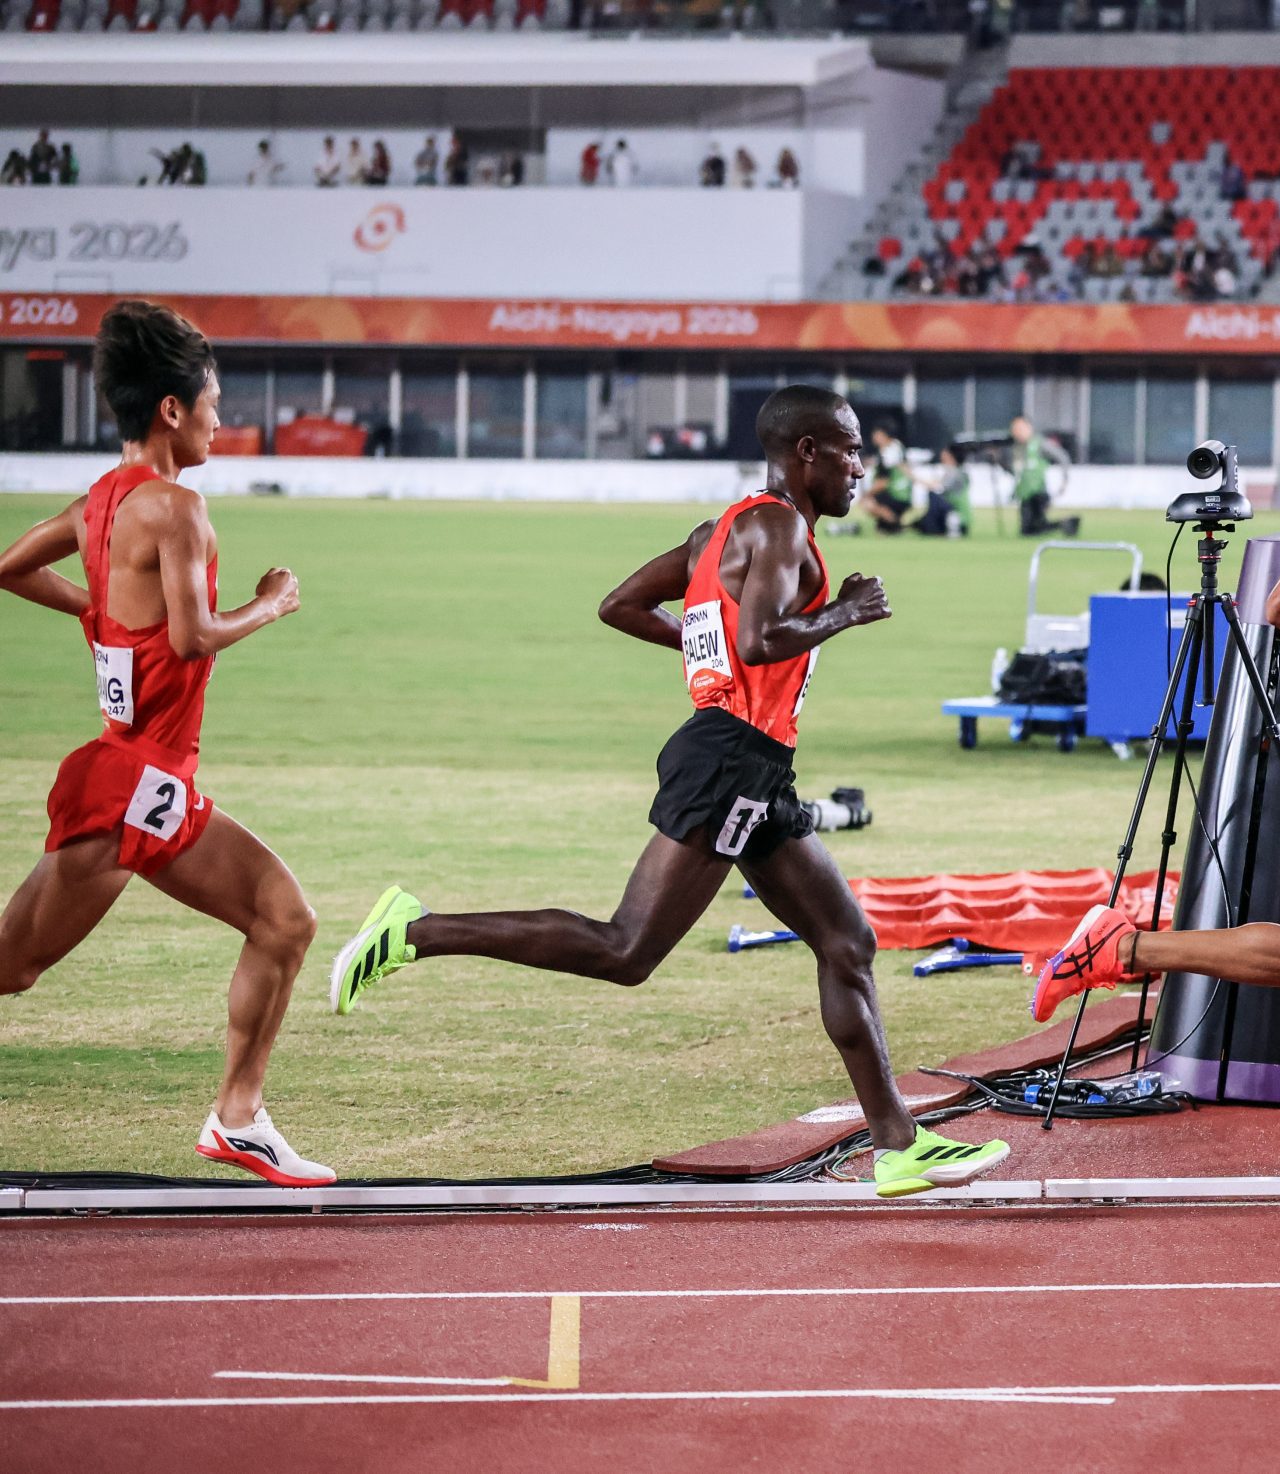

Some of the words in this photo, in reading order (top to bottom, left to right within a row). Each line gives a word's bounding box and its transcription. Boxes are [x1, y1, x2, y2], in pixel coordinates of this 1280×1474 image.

[69, 221, 189, 263] 2026
[9, 298, 78, 325] 2026
[490, 304, 682, 341] Aichi-Nagoya
[687, 307, 759, 334] 2026
[711, 658, 724, 669] 206
[108, 705, 126, 716] 247
[144, 782, 176, 830] 2
